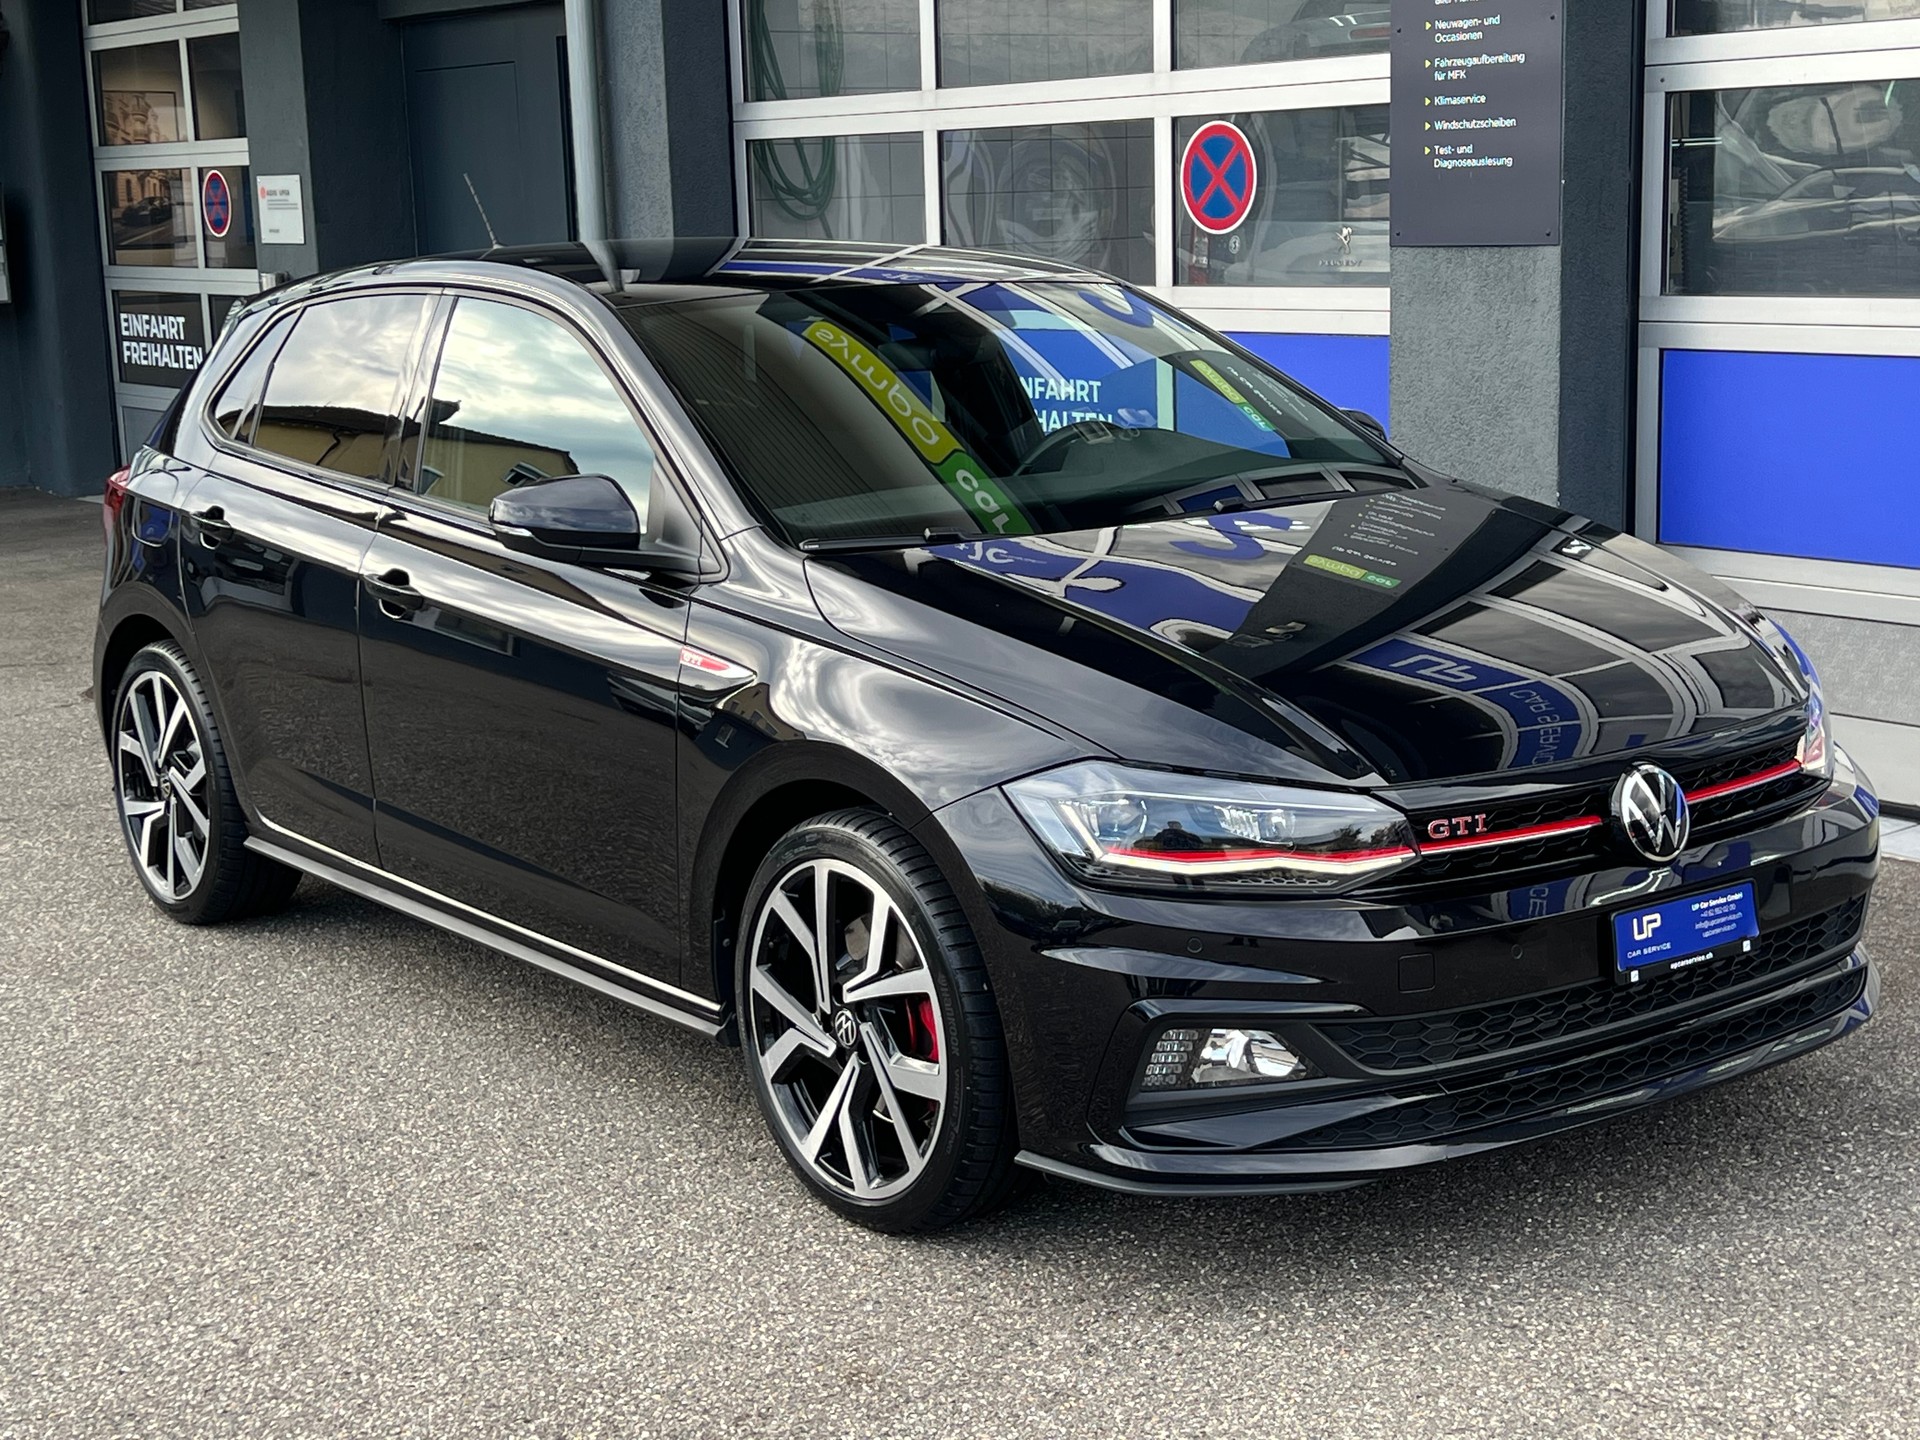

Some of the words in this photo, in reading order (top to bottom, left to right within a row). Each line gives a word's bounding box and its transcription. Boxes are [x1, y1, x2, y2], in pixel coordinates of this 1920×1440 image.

[1435, 19, 1482, 29] Neuwagen-
[1484, 14, 1500, 25] und
[1434, 31, 1483, 43] Occasionen
[1434, 52, 1525, 69] Fahrzeugaufbereitung
[1434, 71, 1446, 81] für
[1447, 70, 1466, 80] MFK
[1434, 94, 1486, 106] Klimaservice
[1434, 117, 1517, 130] Windschutzscheiben
[1434, 145, 1455, 155] Test-
[1456, 144, 1473, 154] und
[1434, 156, 1513, 169] Diagnoseauslesung
[120, 313, 185, 341] EINFAHRT
[123, 341, 203, 371] FREIHALTEN
[1019, 376, 1102, 403] NFAHRT
[1427, 814, 1488, 839] GTI
[1633, 912, 1661, 941] UP
[1627, 948, 1641, 959] CAR
[1643, 942, 1671, 955] SERVICE
